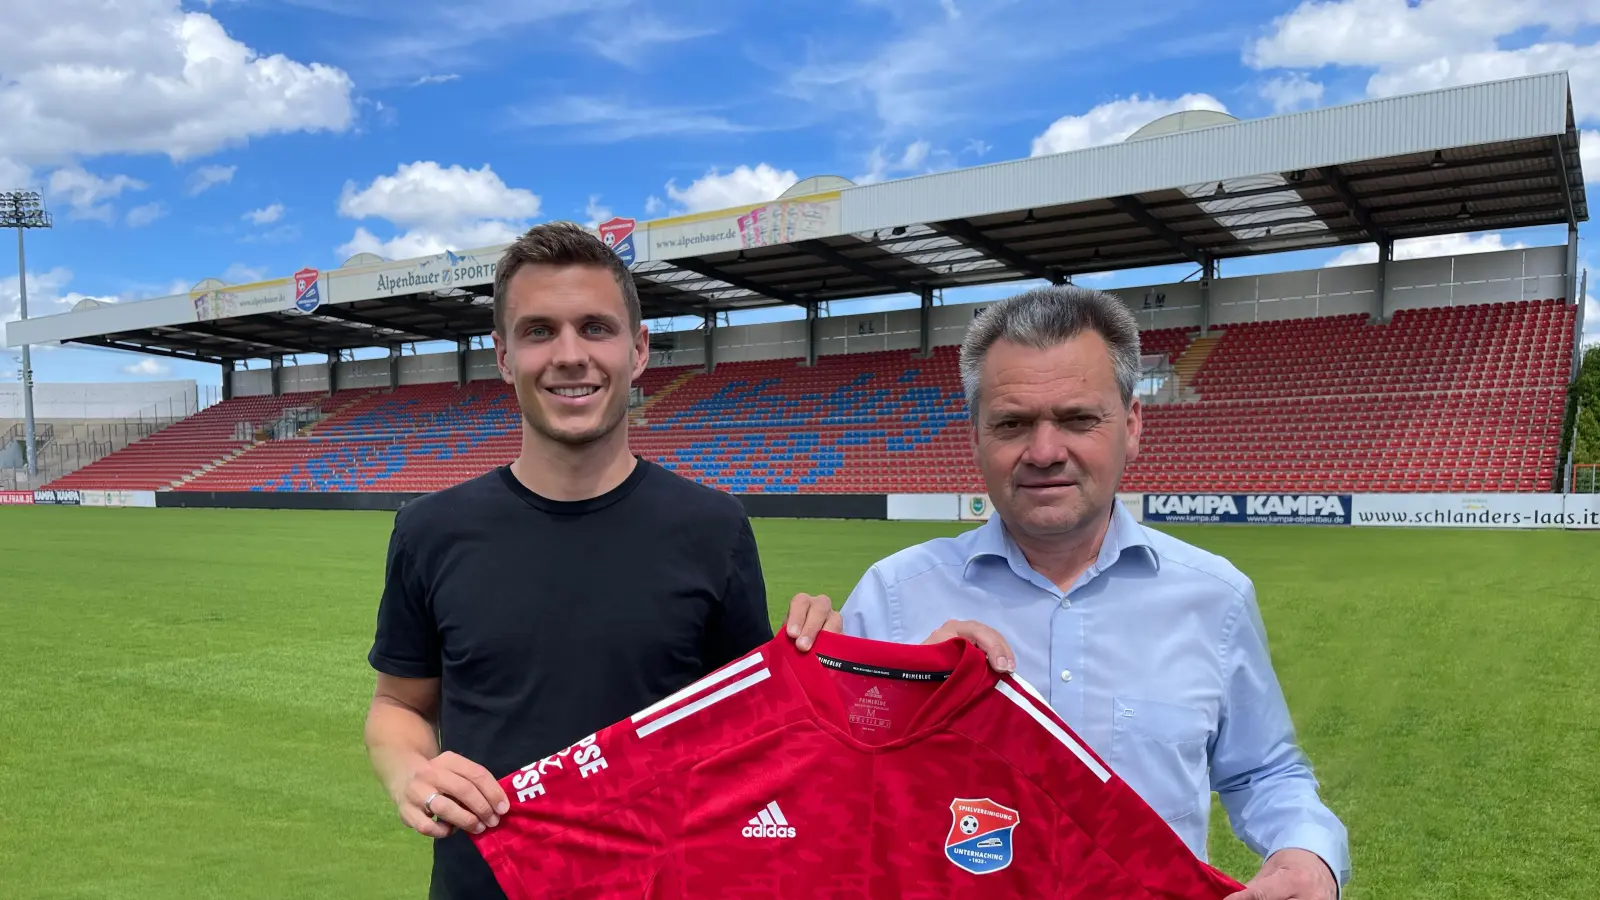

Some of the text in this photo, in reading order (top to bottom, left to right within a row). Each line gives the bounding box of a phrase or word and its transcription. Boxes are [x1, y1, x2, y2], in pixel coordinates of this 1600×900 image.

[655, 228, 736, 248] www.alpenbauer.de
[376, 270, 440, 294] Alpenbauer
[1148, 495, 1239, 515] KAMPA
[1246, 495, 1345, 516] KAMPA
[1165, 515, 1345, 525] www.kampa.de www.kampa-objektbau.de
[1358, 508, 1599, 525] www.schlanders-laas.it
[902, 672, 931, 680] PRIMEBLUE
[866, 708, 876, 718] M
[957, 805, 1013, 821] SPIELVEREINIGUNG
[741, 823, 797, 838] adidas
[953, 847, 1004, 861] UNTERHACHING
